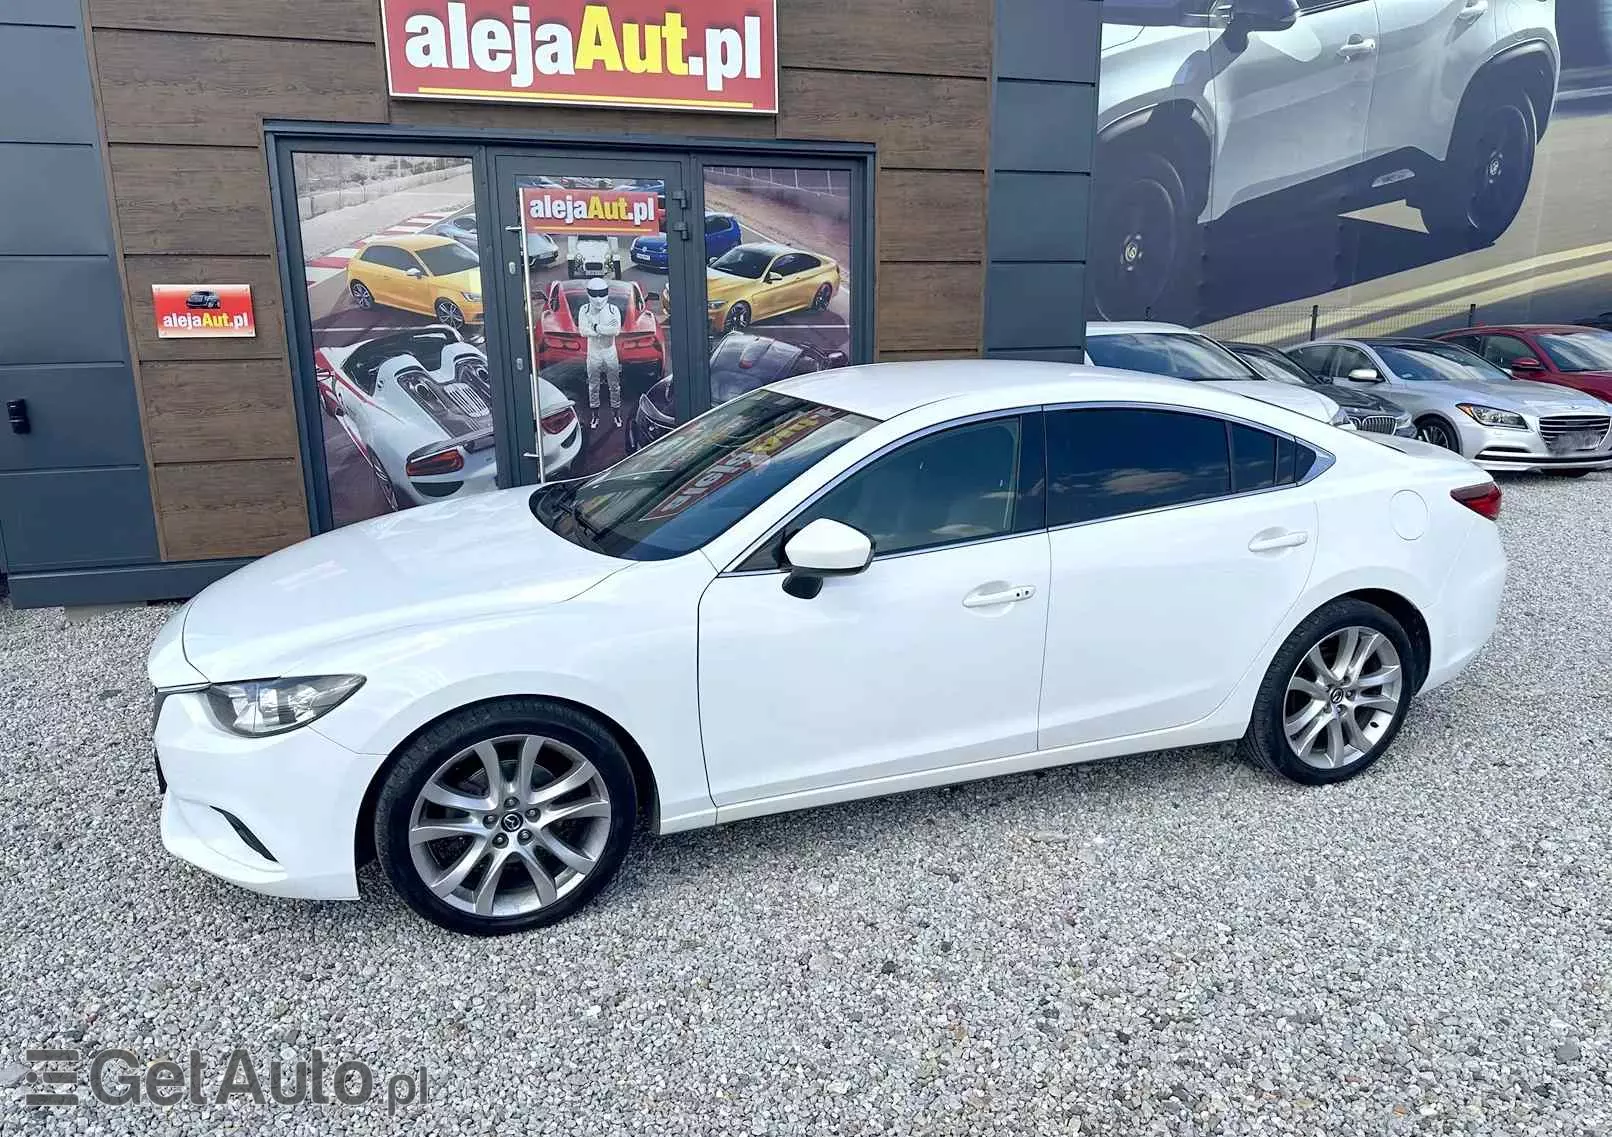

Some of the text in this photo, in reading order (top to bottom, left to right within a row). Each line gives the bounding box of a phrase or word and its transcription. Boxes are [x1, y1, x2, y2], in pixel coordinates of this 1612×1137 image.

[404, 2, 761, 91] alejaAut.pl
[529, 193, 655, 226] alejaAut.pl
[163, 312, 248, 330] alejaAut.pl
